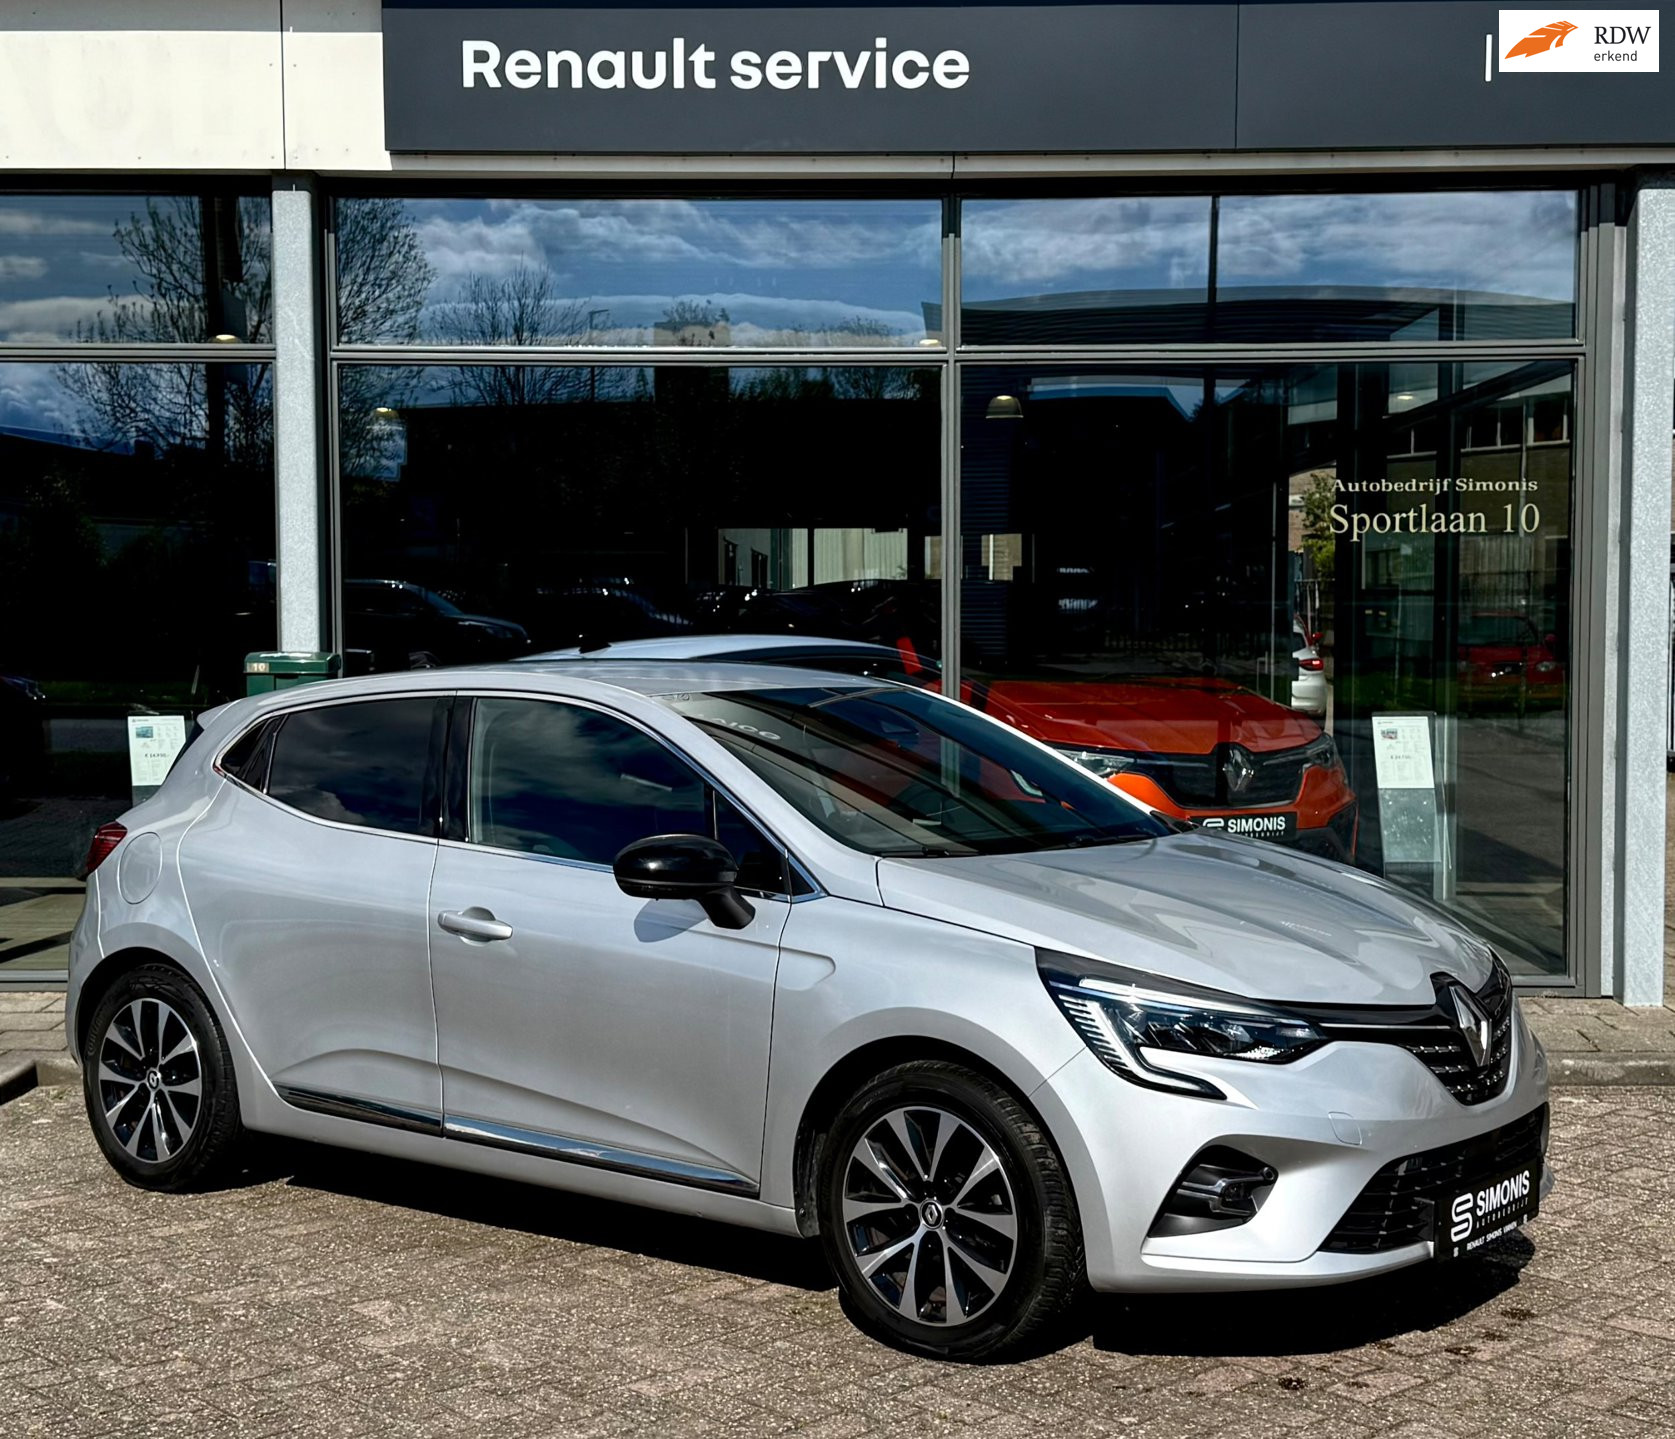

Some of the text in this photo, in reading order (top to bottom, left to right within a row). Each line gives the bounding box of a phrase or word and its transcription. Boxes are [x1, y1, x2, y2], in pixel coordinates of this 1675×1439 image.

[462, 37, 970, 90] Renault service
[1331, 478, 1538, 496] Autobedrijf Simonis
[1329, 503, 1540, 542] Sportlaan 10
[1227, 816, 1286, 833] SIMONIS
[1476, 1170, 1530, 1217] SIMONIS
